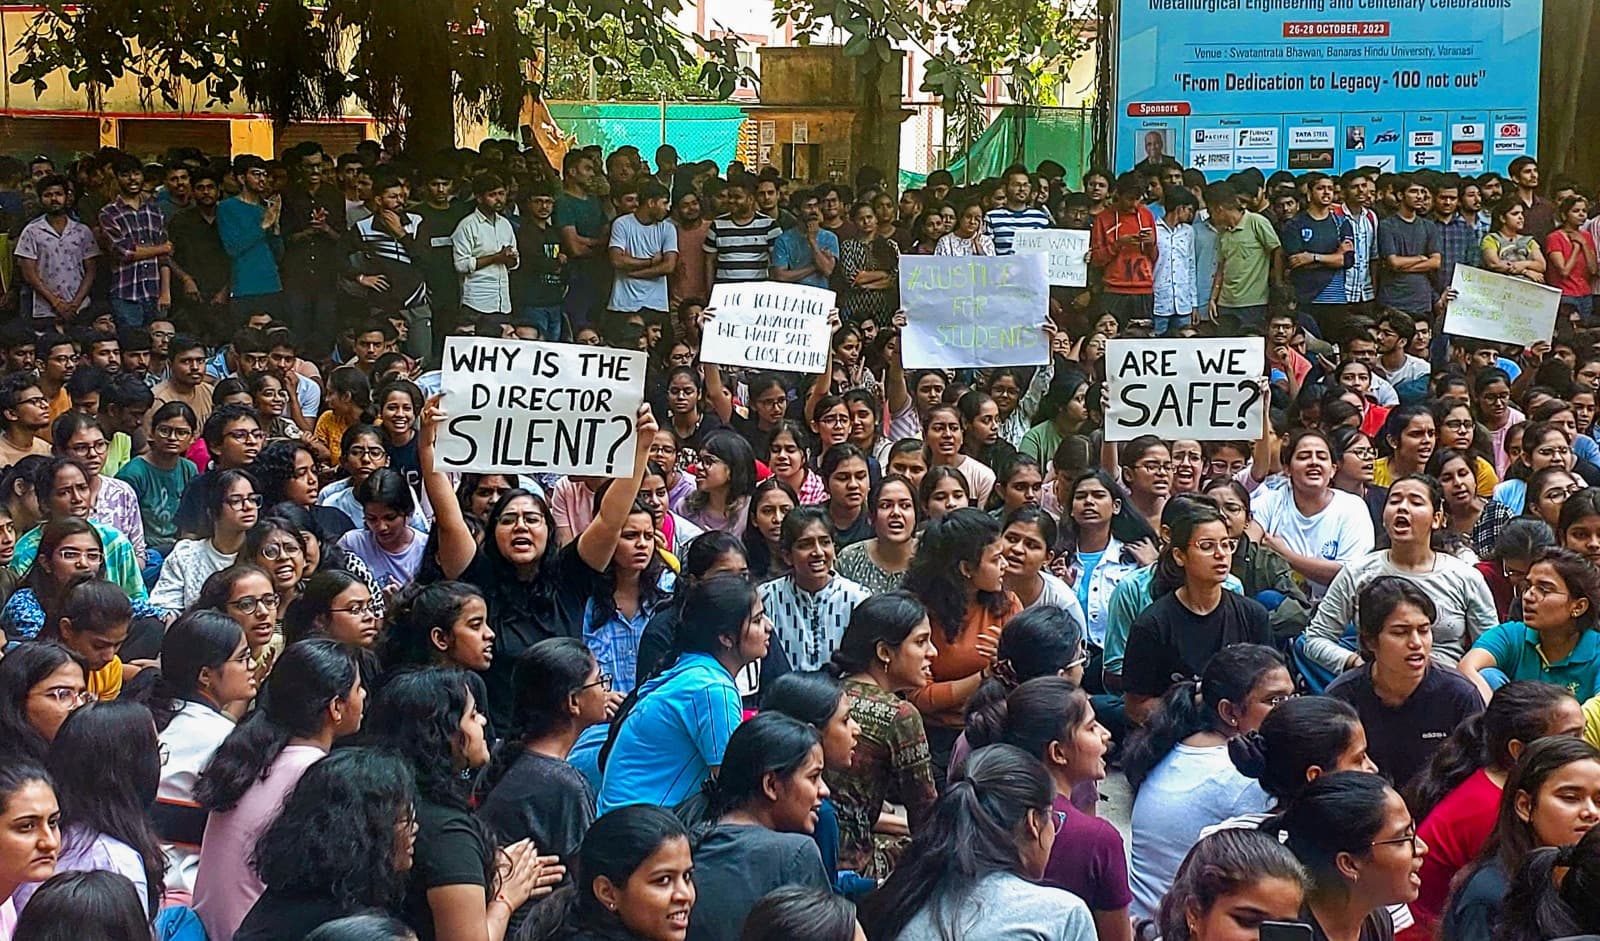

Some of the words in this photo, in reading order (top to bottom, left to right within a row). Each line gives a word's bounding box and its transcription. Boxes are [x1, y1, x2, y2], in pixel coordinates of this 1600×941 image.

[1149, 0, 1241, 12] Metallurgical
[1246, 0, 1325, 12] Engineering
[1359, 0, 1424, 11] Centenary
[1430, 0, 1511, 8] Celebrations
[1288, 24, 1314, 34] 26-28
[1316, 24, 1361, 35] OCTOBER,
[1363, 24, 1385, 34] 2023
[1194, 48, 1222, 58] Venue
[1230, 48, 1284, 58] Swatantrata
[1286, 47, 1324, 59] Bhawan,
[1326, 47, 1362, 57] Banaras
[1364, 46, 1389, 57] Hindu
[1391, 46, 1436, 58] University,
[1437, 45, 1474, 56] Varanasi
[1225, 73, 1304, 91] Dedication
[1309, 73, 1325, 90] to
[1392, 70, 1421, 88] 100
[1426, 72, 1449, 89] not
[1139, 103, 1179, 114] Sponsors
[1048, 238, 1087, 251] WANT
[717, 321, 741, 339] WE
[934, 324, 1038, 349] STUDENTS
[450, 345, 521, 372] WHY
[532, 350, 560, 379] IS
[578, 353, 632, 382] THE
[744, 345, 785, 364] CLOSE
[1118, 349, 1178, 378] ARE
[1196, 348, 1247, 375] WE
[471, 383, 613, 413] DIRECTOR
[1117, 379, 1261, 430] SAFE?
[443, 414, 633, 474] SILENT?
